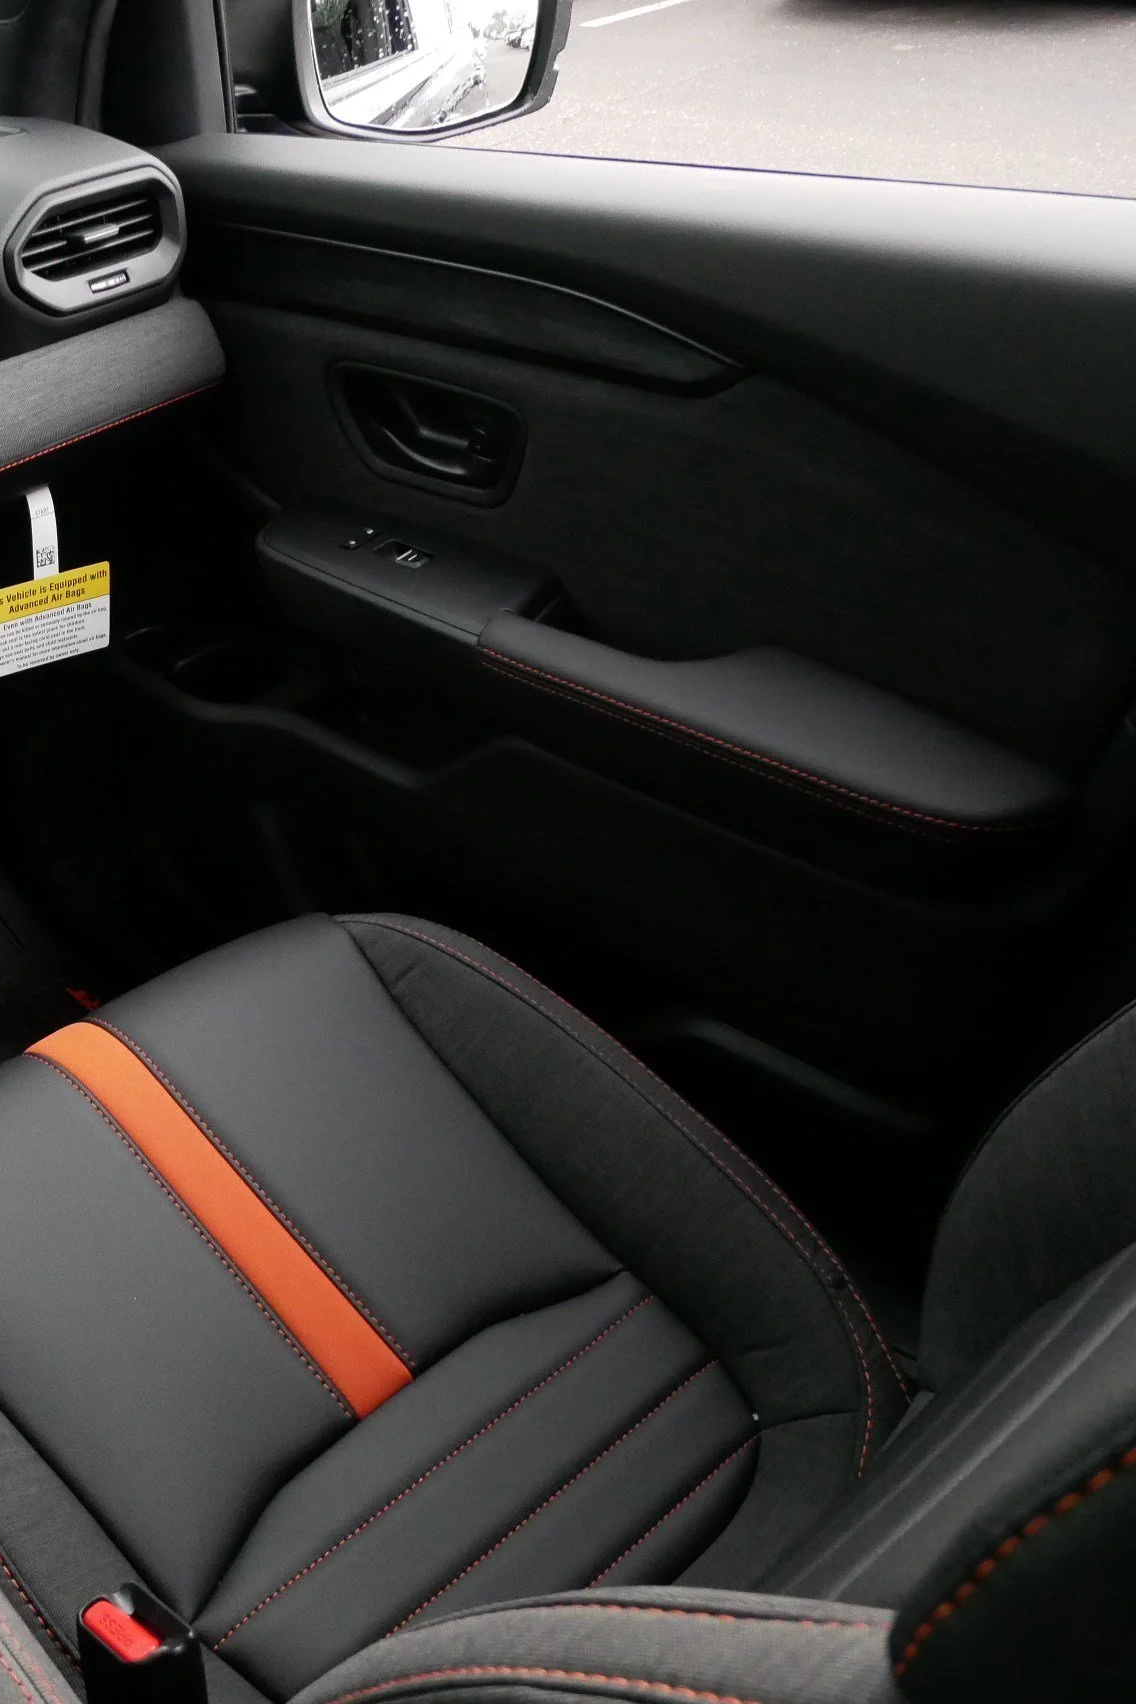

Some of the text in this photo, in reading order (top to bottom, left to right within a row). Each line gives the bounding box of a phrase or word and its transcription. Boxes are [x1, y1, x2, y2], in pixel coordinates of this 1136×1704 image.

[6, 587, 36, 603] Vehicle
[39, 584, 46, 594] is
[49, 573, 87, 592] Equipped
[89, 568, 106, 581] with
[8, 585, 85, 614] Advanced Air Bags
[3, 600, 91, 630] Even with Advanced Air Bags
